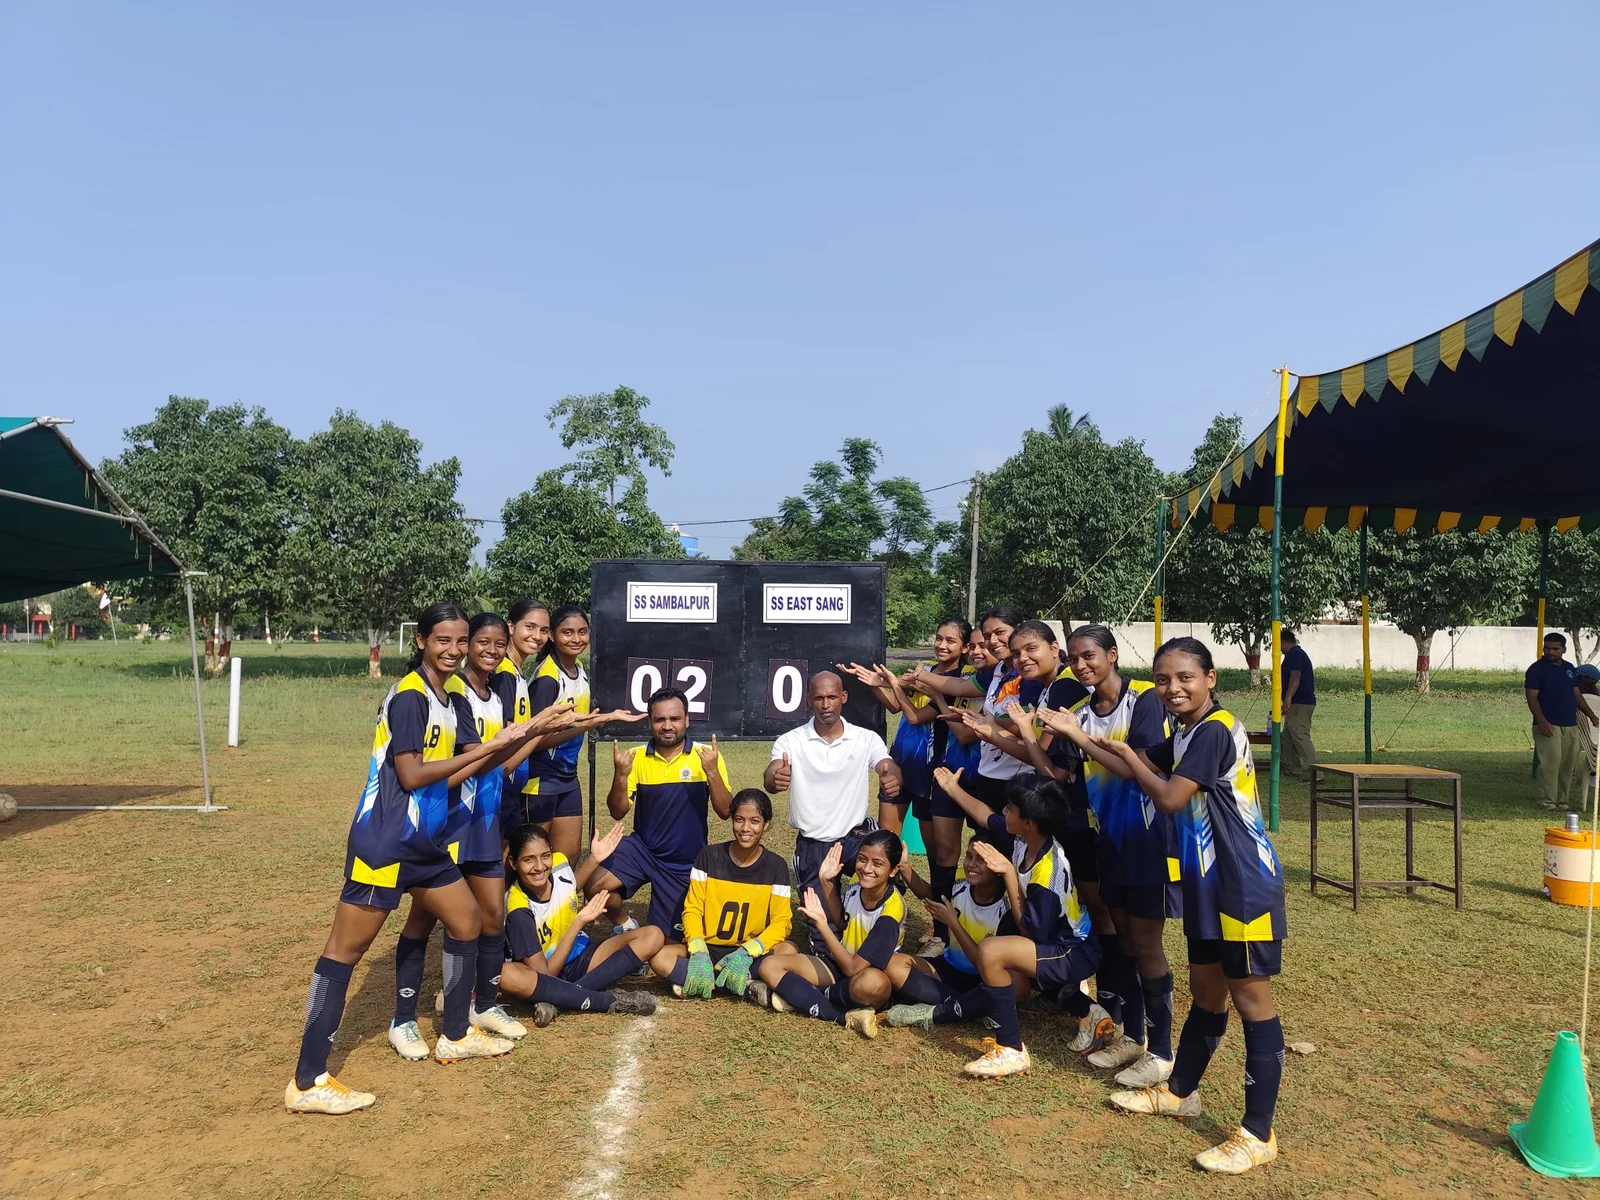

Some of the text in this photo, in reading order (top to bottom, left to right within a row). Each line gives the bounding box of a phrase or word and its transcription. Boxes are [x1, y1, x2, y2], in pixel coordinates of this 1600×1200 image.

[634, 595, 710, 610] SS SAMBALPUR
[771, 596, 844, 611] SS EAST SANG
[772, 665, 803, 713] 0
[716, 901, 750, 942] 01
[538, 922, 553, 944] 14
